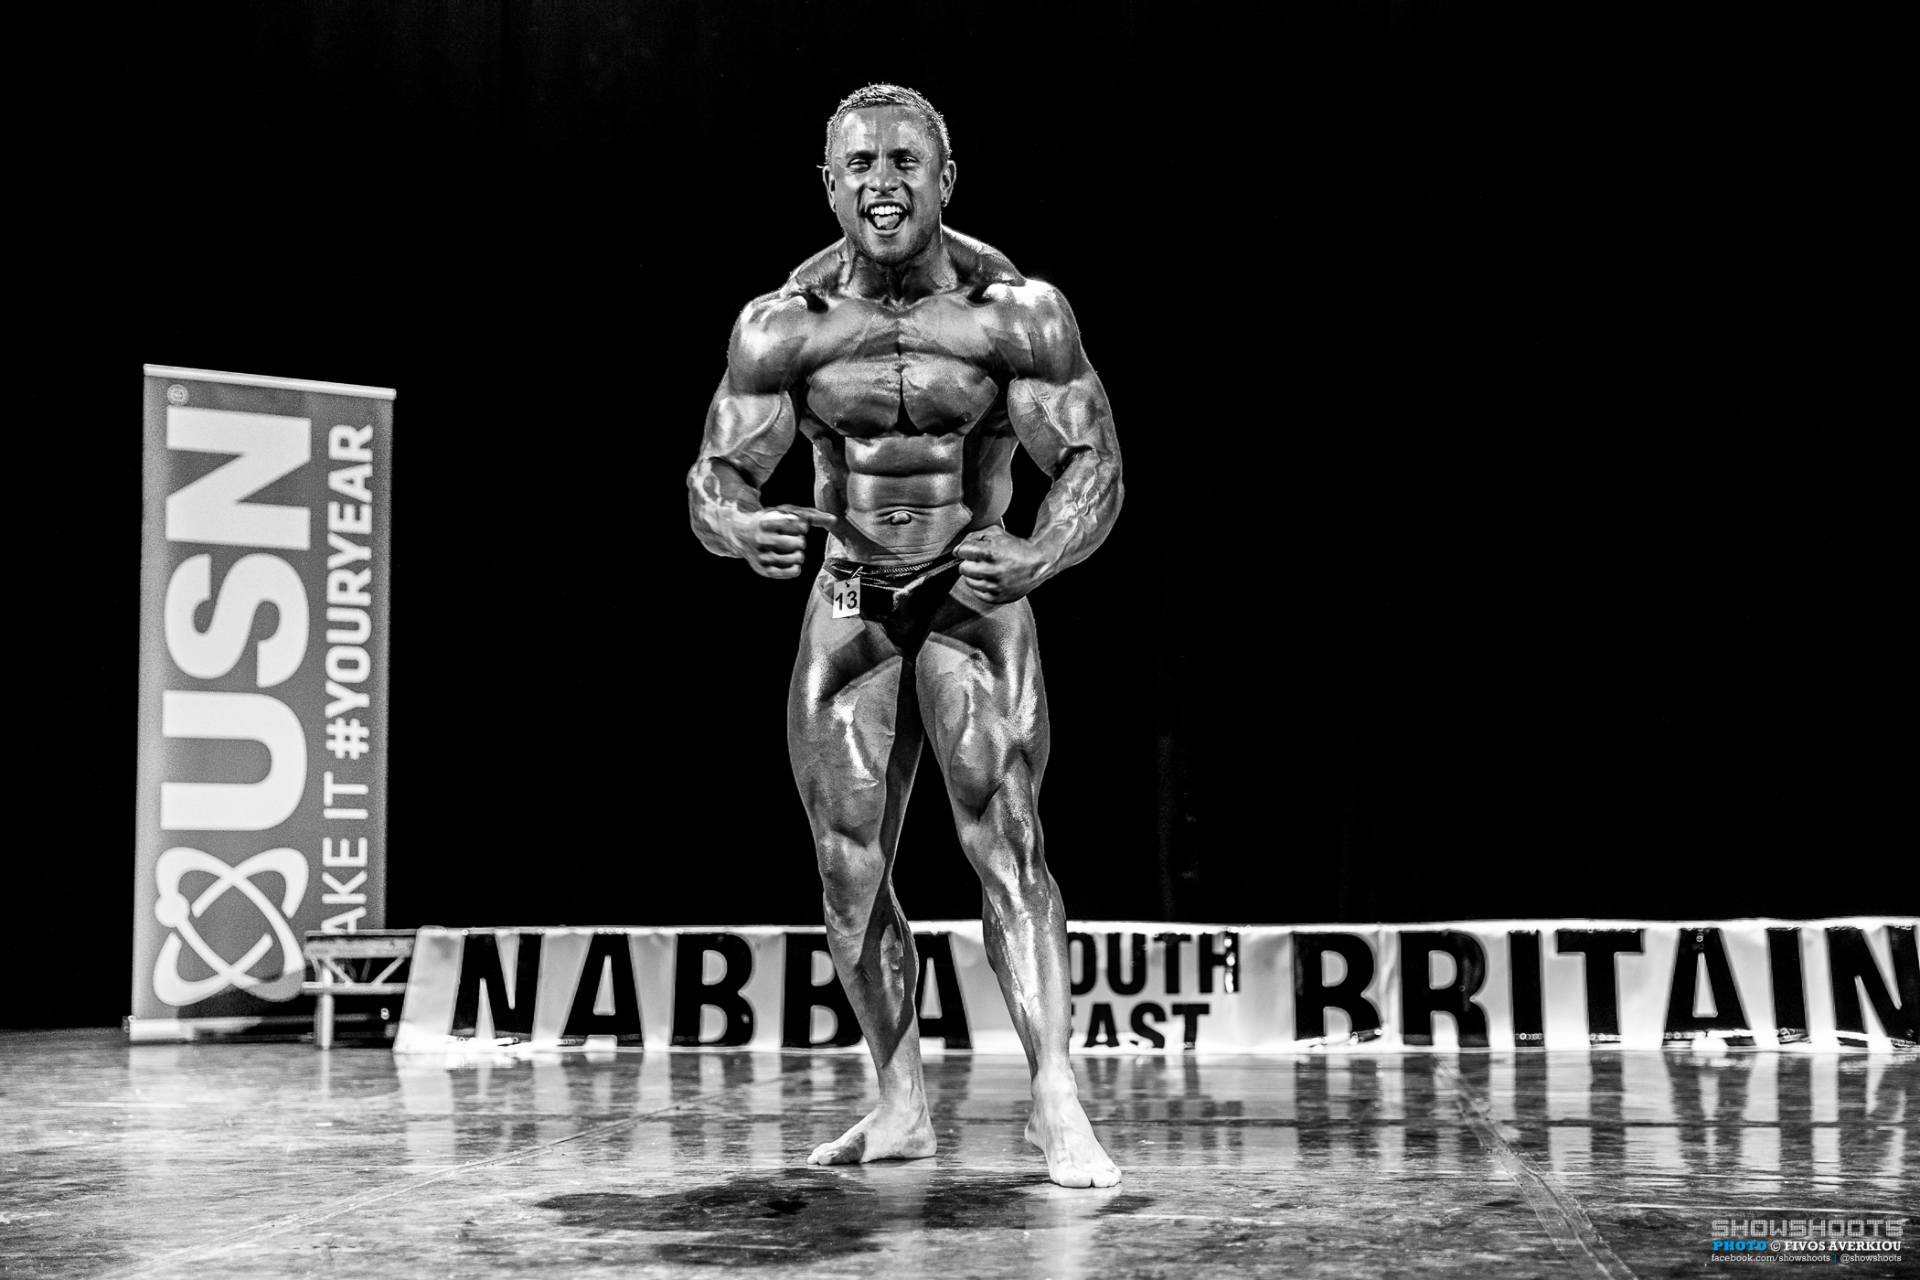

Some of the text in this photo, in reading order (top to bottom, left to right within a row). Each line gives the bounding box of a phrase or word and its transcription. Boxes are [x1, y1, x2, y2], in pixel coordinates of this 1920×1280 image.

[160, 404, 312, 831] USN
[835, 590, 858, 611] 13
[321, 424, 374, 933] AKE IT #YOURYEAR
[450, 925, 1920, 1049] NABBA BRITAIN
[1068, 931, 1240, 996] OUTH
[1070, 1002, 1210, 1048] AST
